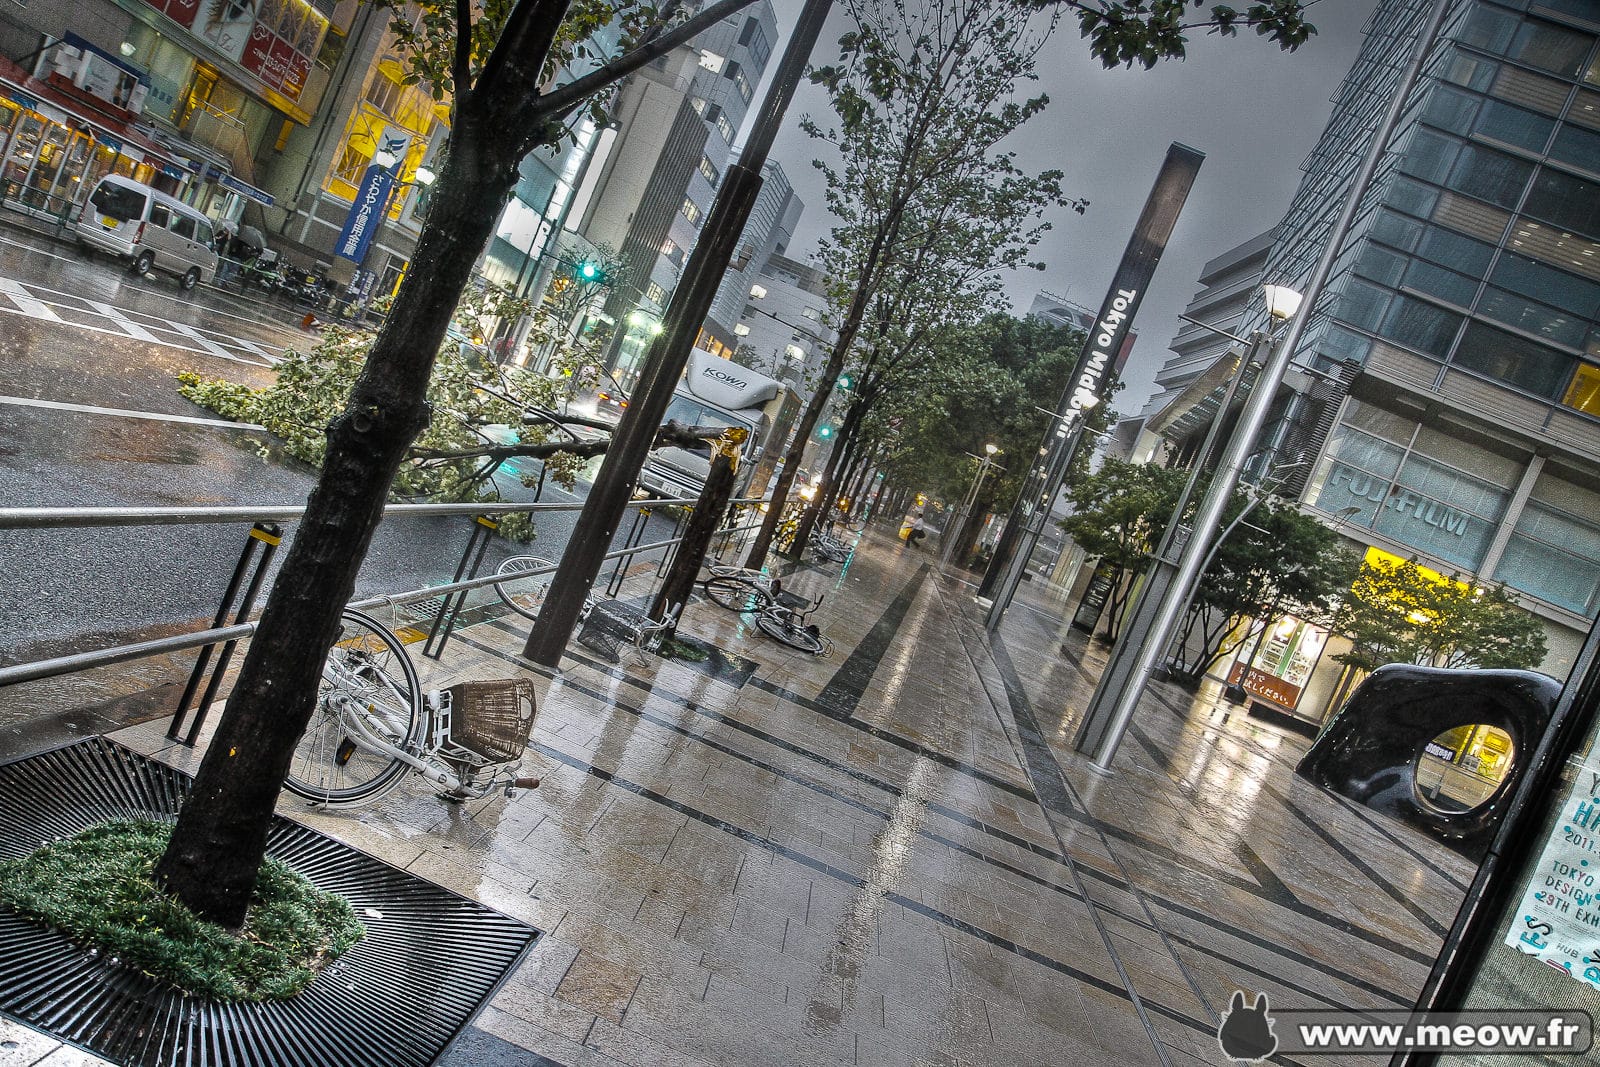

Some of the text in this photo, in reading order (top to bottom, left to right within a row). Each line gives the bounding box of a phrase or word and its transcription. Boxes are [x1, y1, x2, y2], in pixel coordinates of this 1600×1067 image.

[342, 175, 384, 256] さわやか信用金庫
[1097, 289, 1136, 347] Tokyo
[704, 367, 748, 388] KOWA
[1552, 860, 1594, 887] TOKYO
[1538, 890, 1569, 913] 29TH
[1545, 875, 1592, 905] DESIGN
[1556, 943, 1579, 959] HUB
